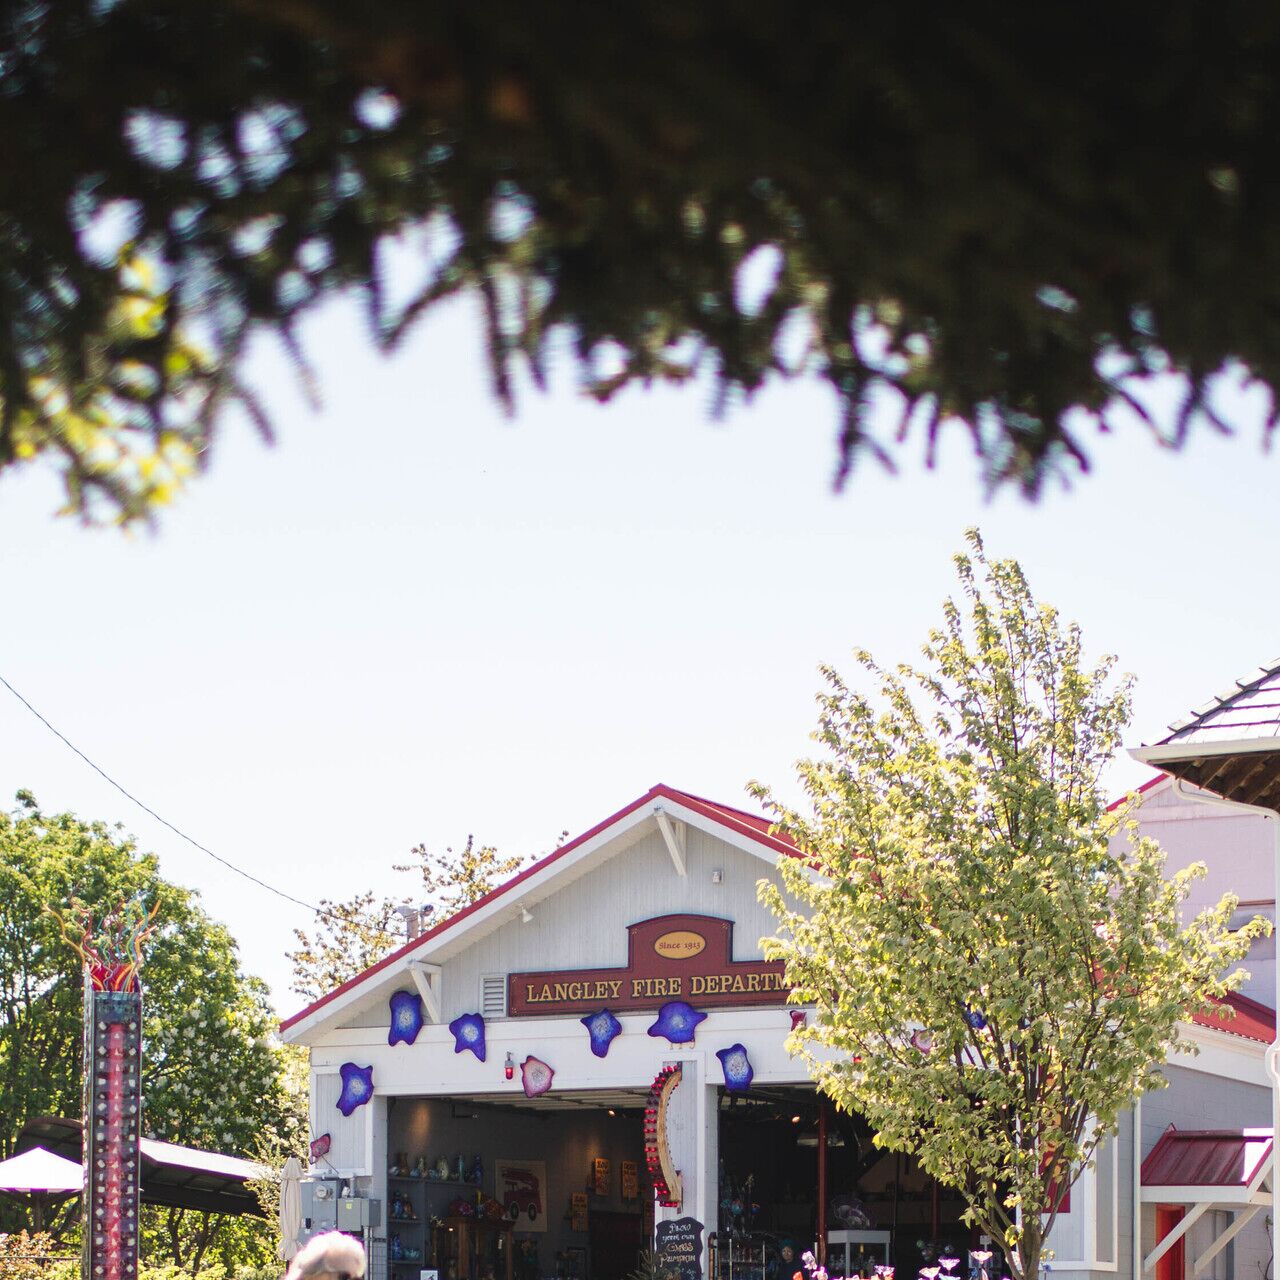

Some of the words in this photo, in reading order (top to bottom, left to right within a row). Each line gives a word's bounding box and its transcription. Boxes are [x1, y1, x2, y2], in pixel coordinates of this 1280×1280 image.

[659, 941, 681, 950] Since
[526, 980, 623, 1002] LANGLEY
[631, 977, 682, 998] FIRE
[691, 973, 801, 995] DEPARTM
